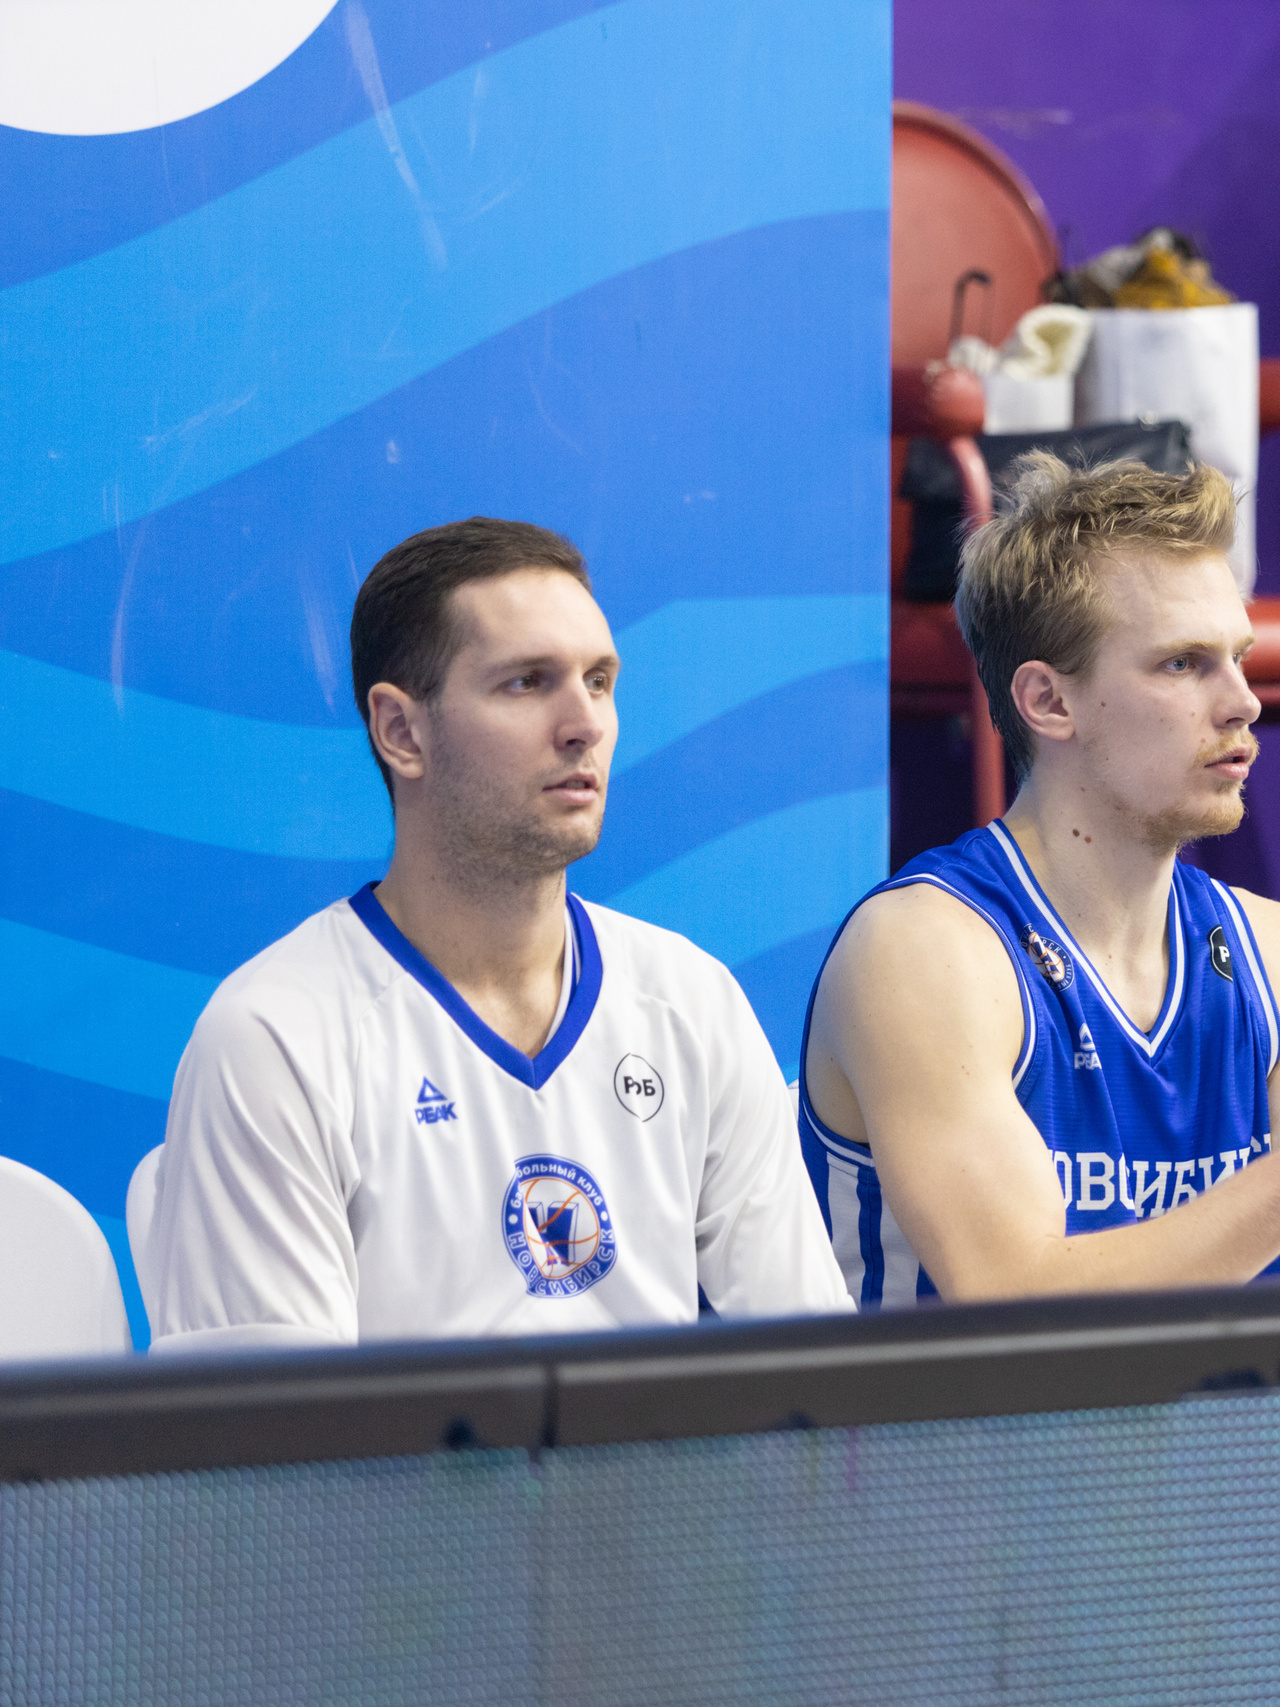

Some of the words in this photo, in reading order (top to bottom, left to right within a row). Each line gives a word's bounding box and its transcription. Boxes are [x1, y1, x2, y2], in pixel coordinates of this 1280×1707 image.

[1074, 1052, 1102, 1070] PEA
[414, 1102, 459, 1125] PEAK
[510, 1163, 577, 1208] бабольный
[577, 1176, 603, 1206] клуб
[508, 1228, 615, 1296] НОВСИБИРСК
